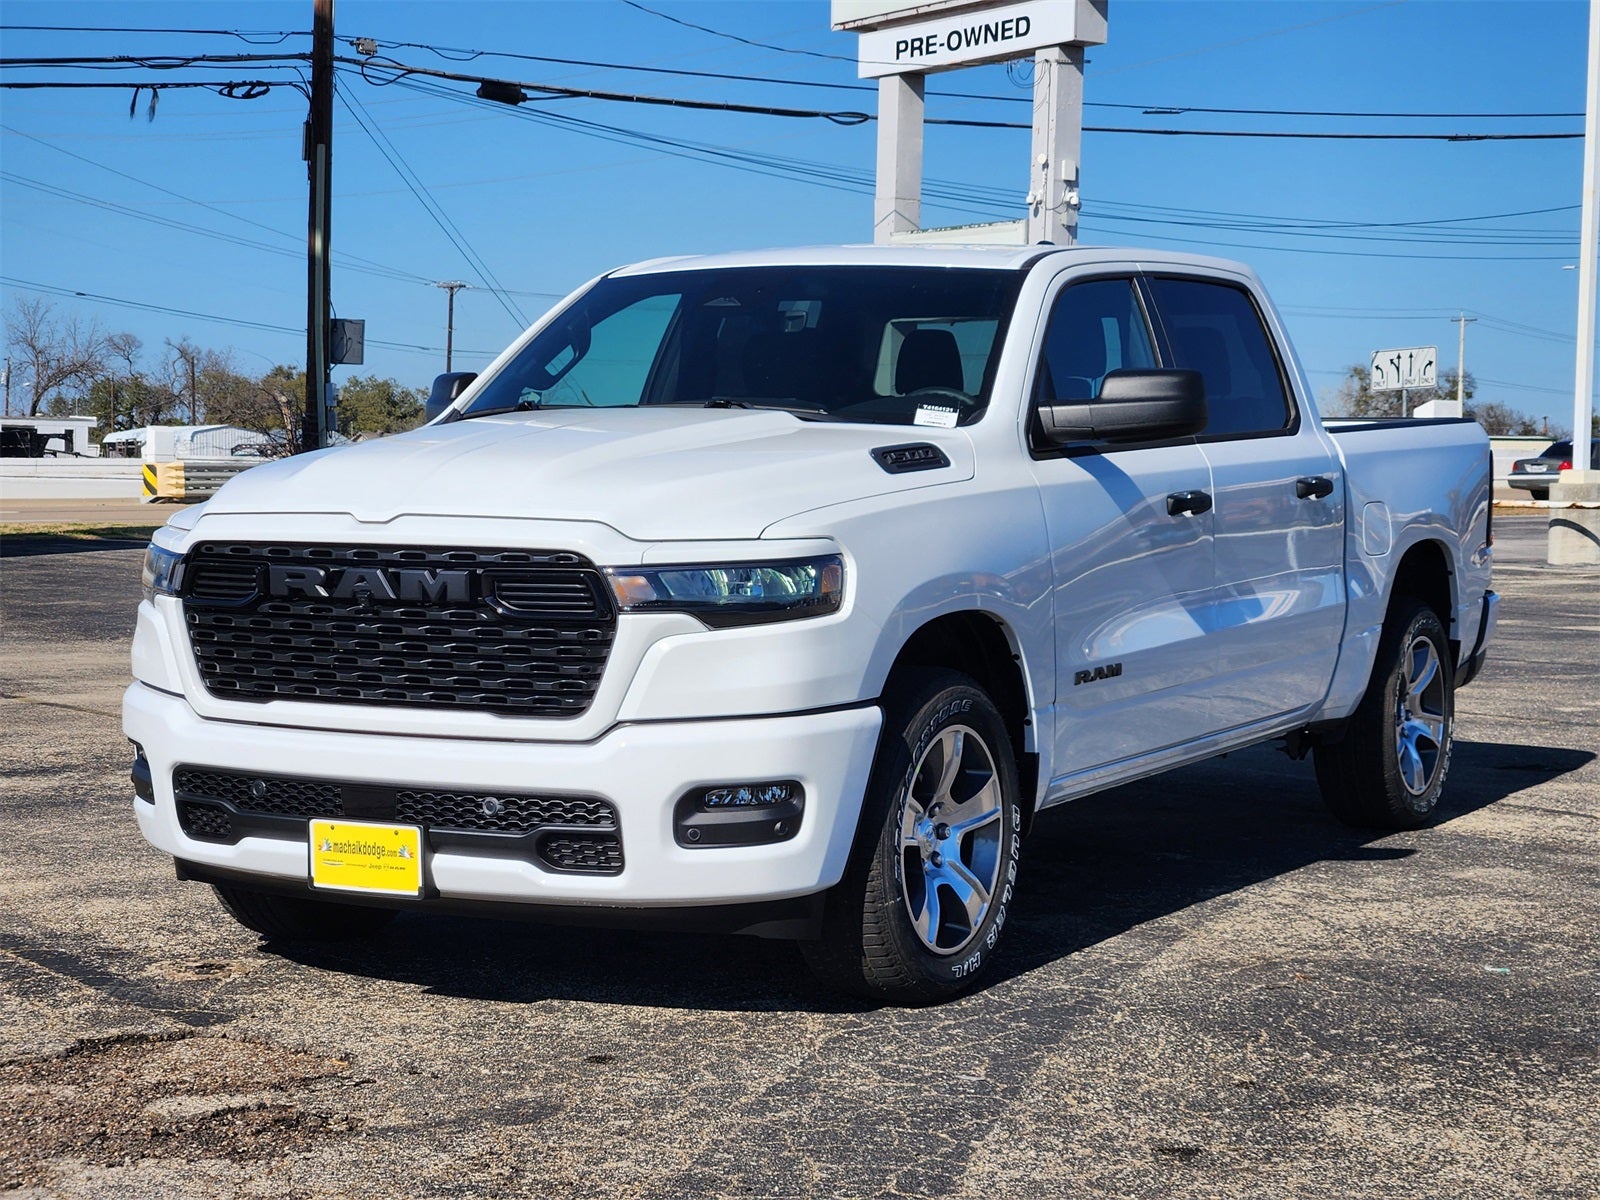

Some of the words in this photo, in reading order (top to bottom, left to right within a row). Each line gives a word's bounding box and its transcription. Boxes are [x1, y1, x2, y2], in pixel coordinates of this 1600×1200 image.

[896, 16, 1031, 60] PRE-OWNED
[269, 564, 470, 604] RAM
[1074, 662, 1122, 686] RAM
[333, 840, 398, 860] machaikdodge.com
